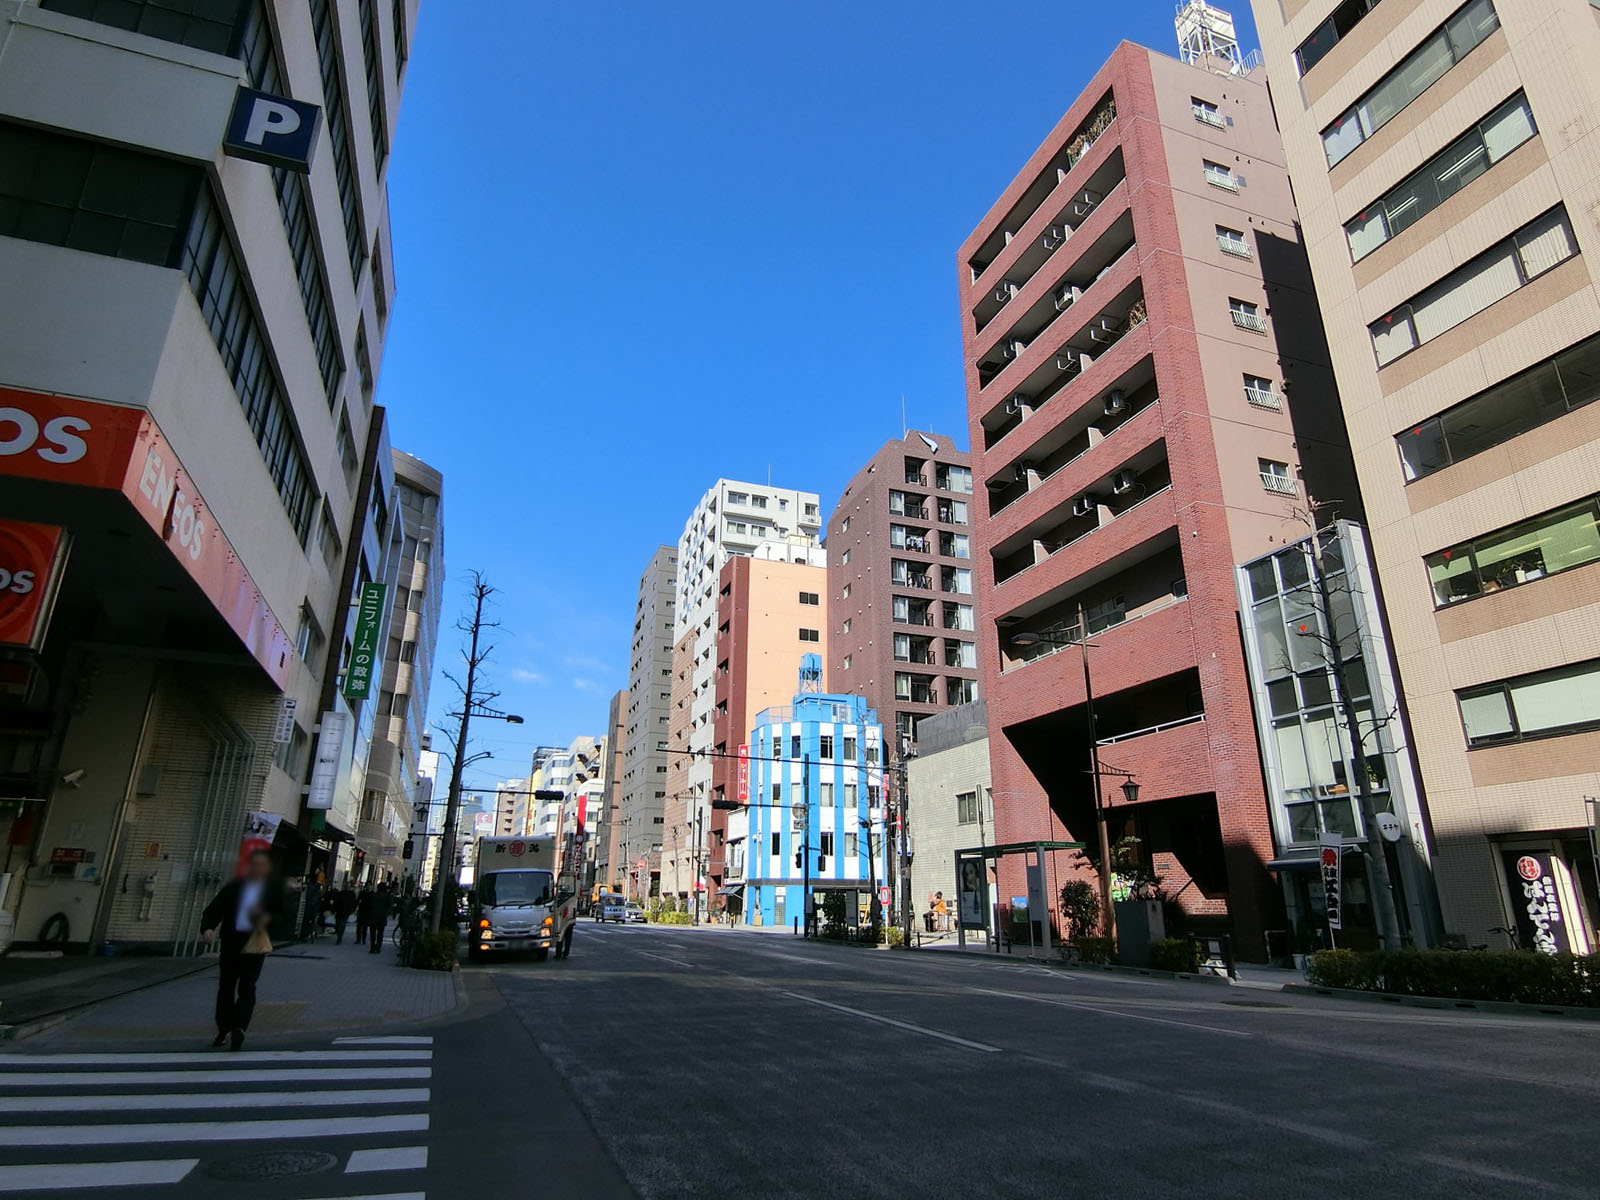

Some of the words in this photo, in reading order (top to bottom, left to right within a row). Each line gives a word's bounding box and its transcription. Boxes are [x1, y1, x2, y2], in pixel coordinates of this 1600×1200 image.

[244, 97, 301, 146] P
[0, 407, 92, 464] OS
[351, 589, 379, 691] ユニフォームの政弥
